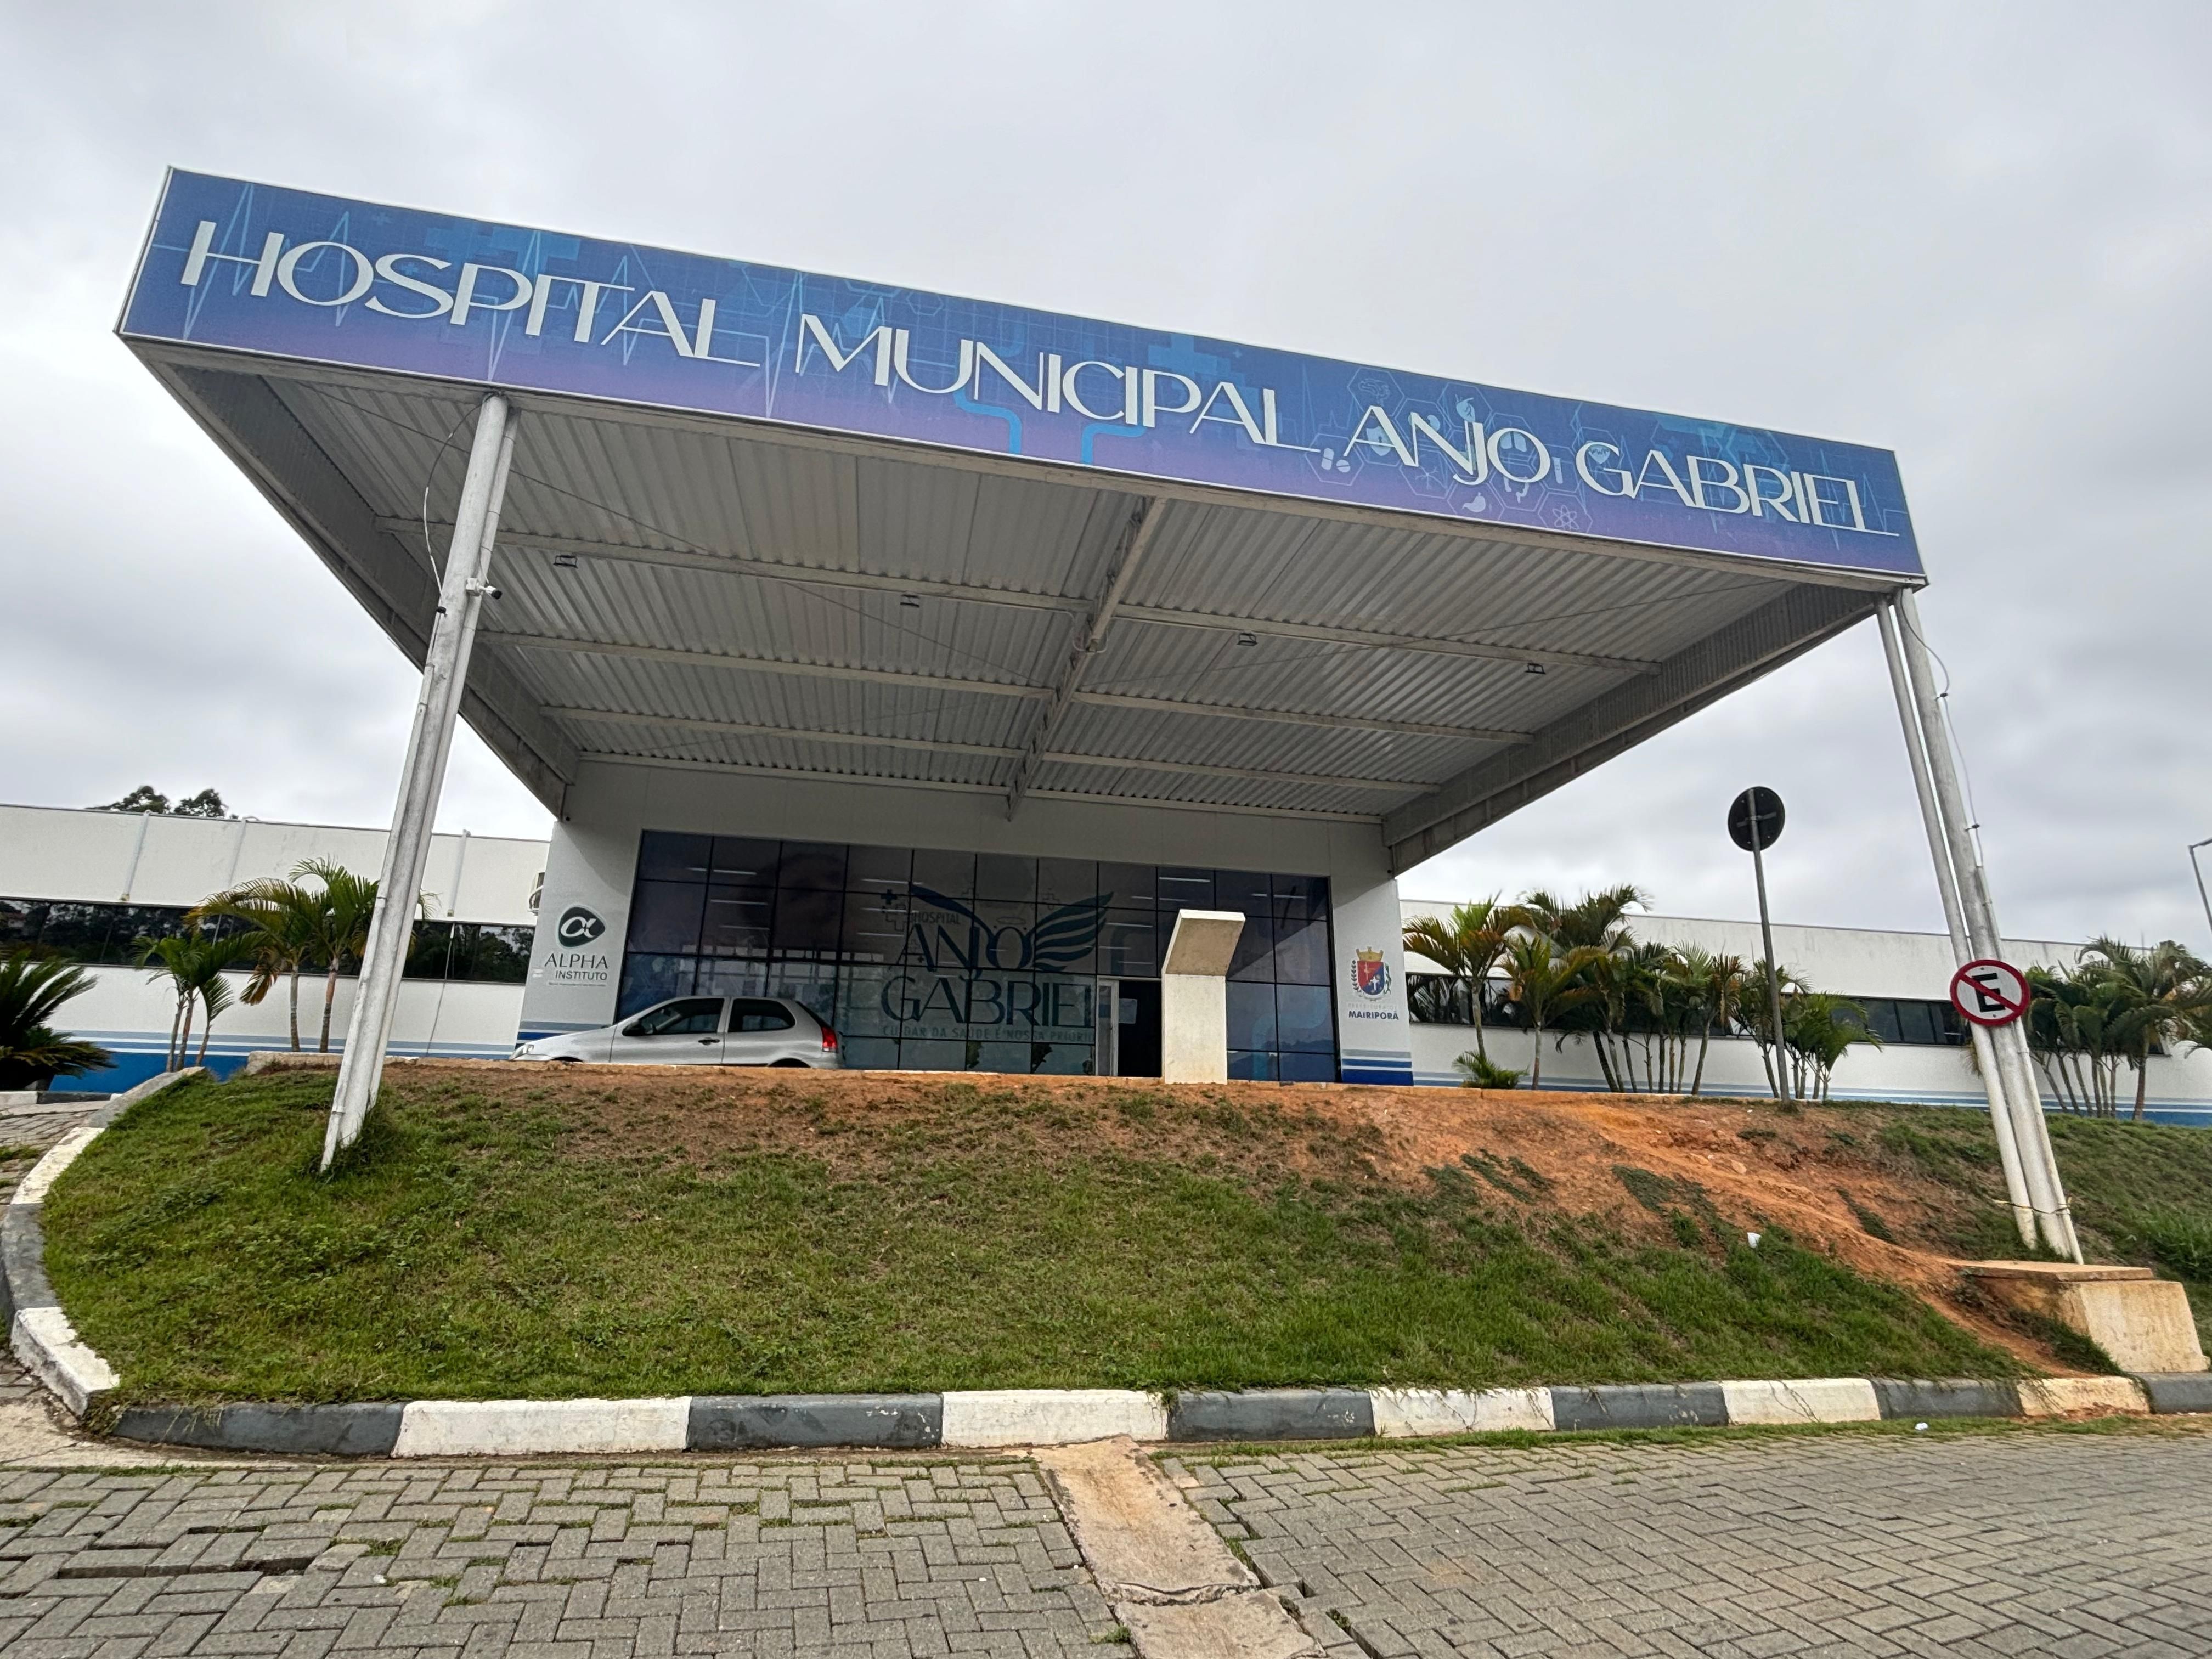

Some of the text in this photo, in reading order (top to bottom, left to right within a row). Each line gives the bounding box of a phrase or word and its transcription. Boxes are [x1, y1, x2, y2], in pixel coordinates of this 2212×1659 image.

[180, 220, 1900, 537] HOSPITAL MUNICIPAL ANJO GABRIEL
[913, 911, 961, 924] HOSPITAL
[888, 923, 1033, 980] ANJO
[544, 953, 608, 969] ALPHA
[555, 970, 607, 980] INSTITUTO
[1972, 973, 2006, 1013] E
[881, 975, 1095, 1028] GABRIEL
[1348, 1011, 1399, 1020] MAIRIPORÃ
[883, 1026, 926, 1036] CUDAR
[931, 1026, 947, 1037] DA
